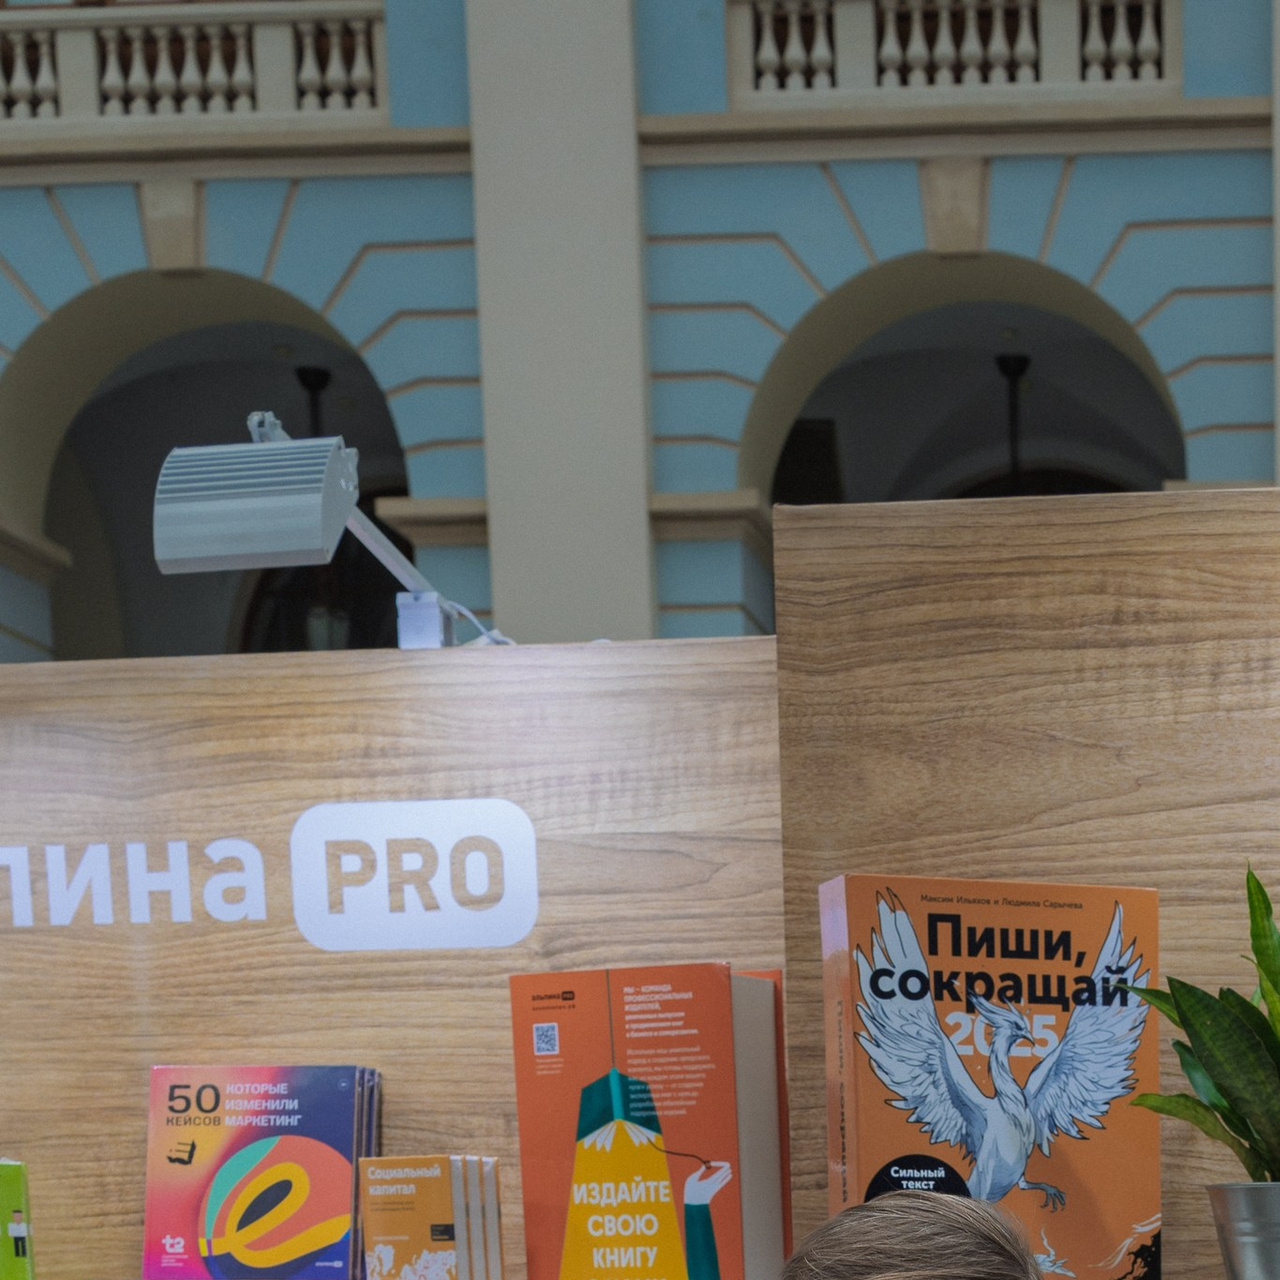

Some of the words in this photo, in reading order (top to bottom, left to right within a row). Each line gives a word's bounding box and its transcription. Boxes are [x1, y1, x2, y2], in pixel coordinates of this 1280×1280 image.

[324, 835, 506, 915] PRO
[927, 913, 1086, 967] Пиши,
[870, 966, 1129, 1013] сокращай
[226, 1083, 288, 1095] КОТОРЫЕ
[168, 1084, 220, 1114] 50
[225, 1099, 299, 1111] ИЗМЕНИЛИ
[166, 1115, 221, 1127] КЕЙСОВ
[225, 1114, 302, 1127] МАРКЕТИНГ
[368, 1165, 441, 1180] Социальный
[890, 1166, 945, 1178] Сильный
[369, 1183, 416, 1196] капитал
[573, 1176, 671, 1207] ИЗДАЙТЕ
[901, 1179, 935, 1190] текст
[587, 1214, 659, 1236] СВОЮ
[593, 1246, 658, 1268] КНИГУ
